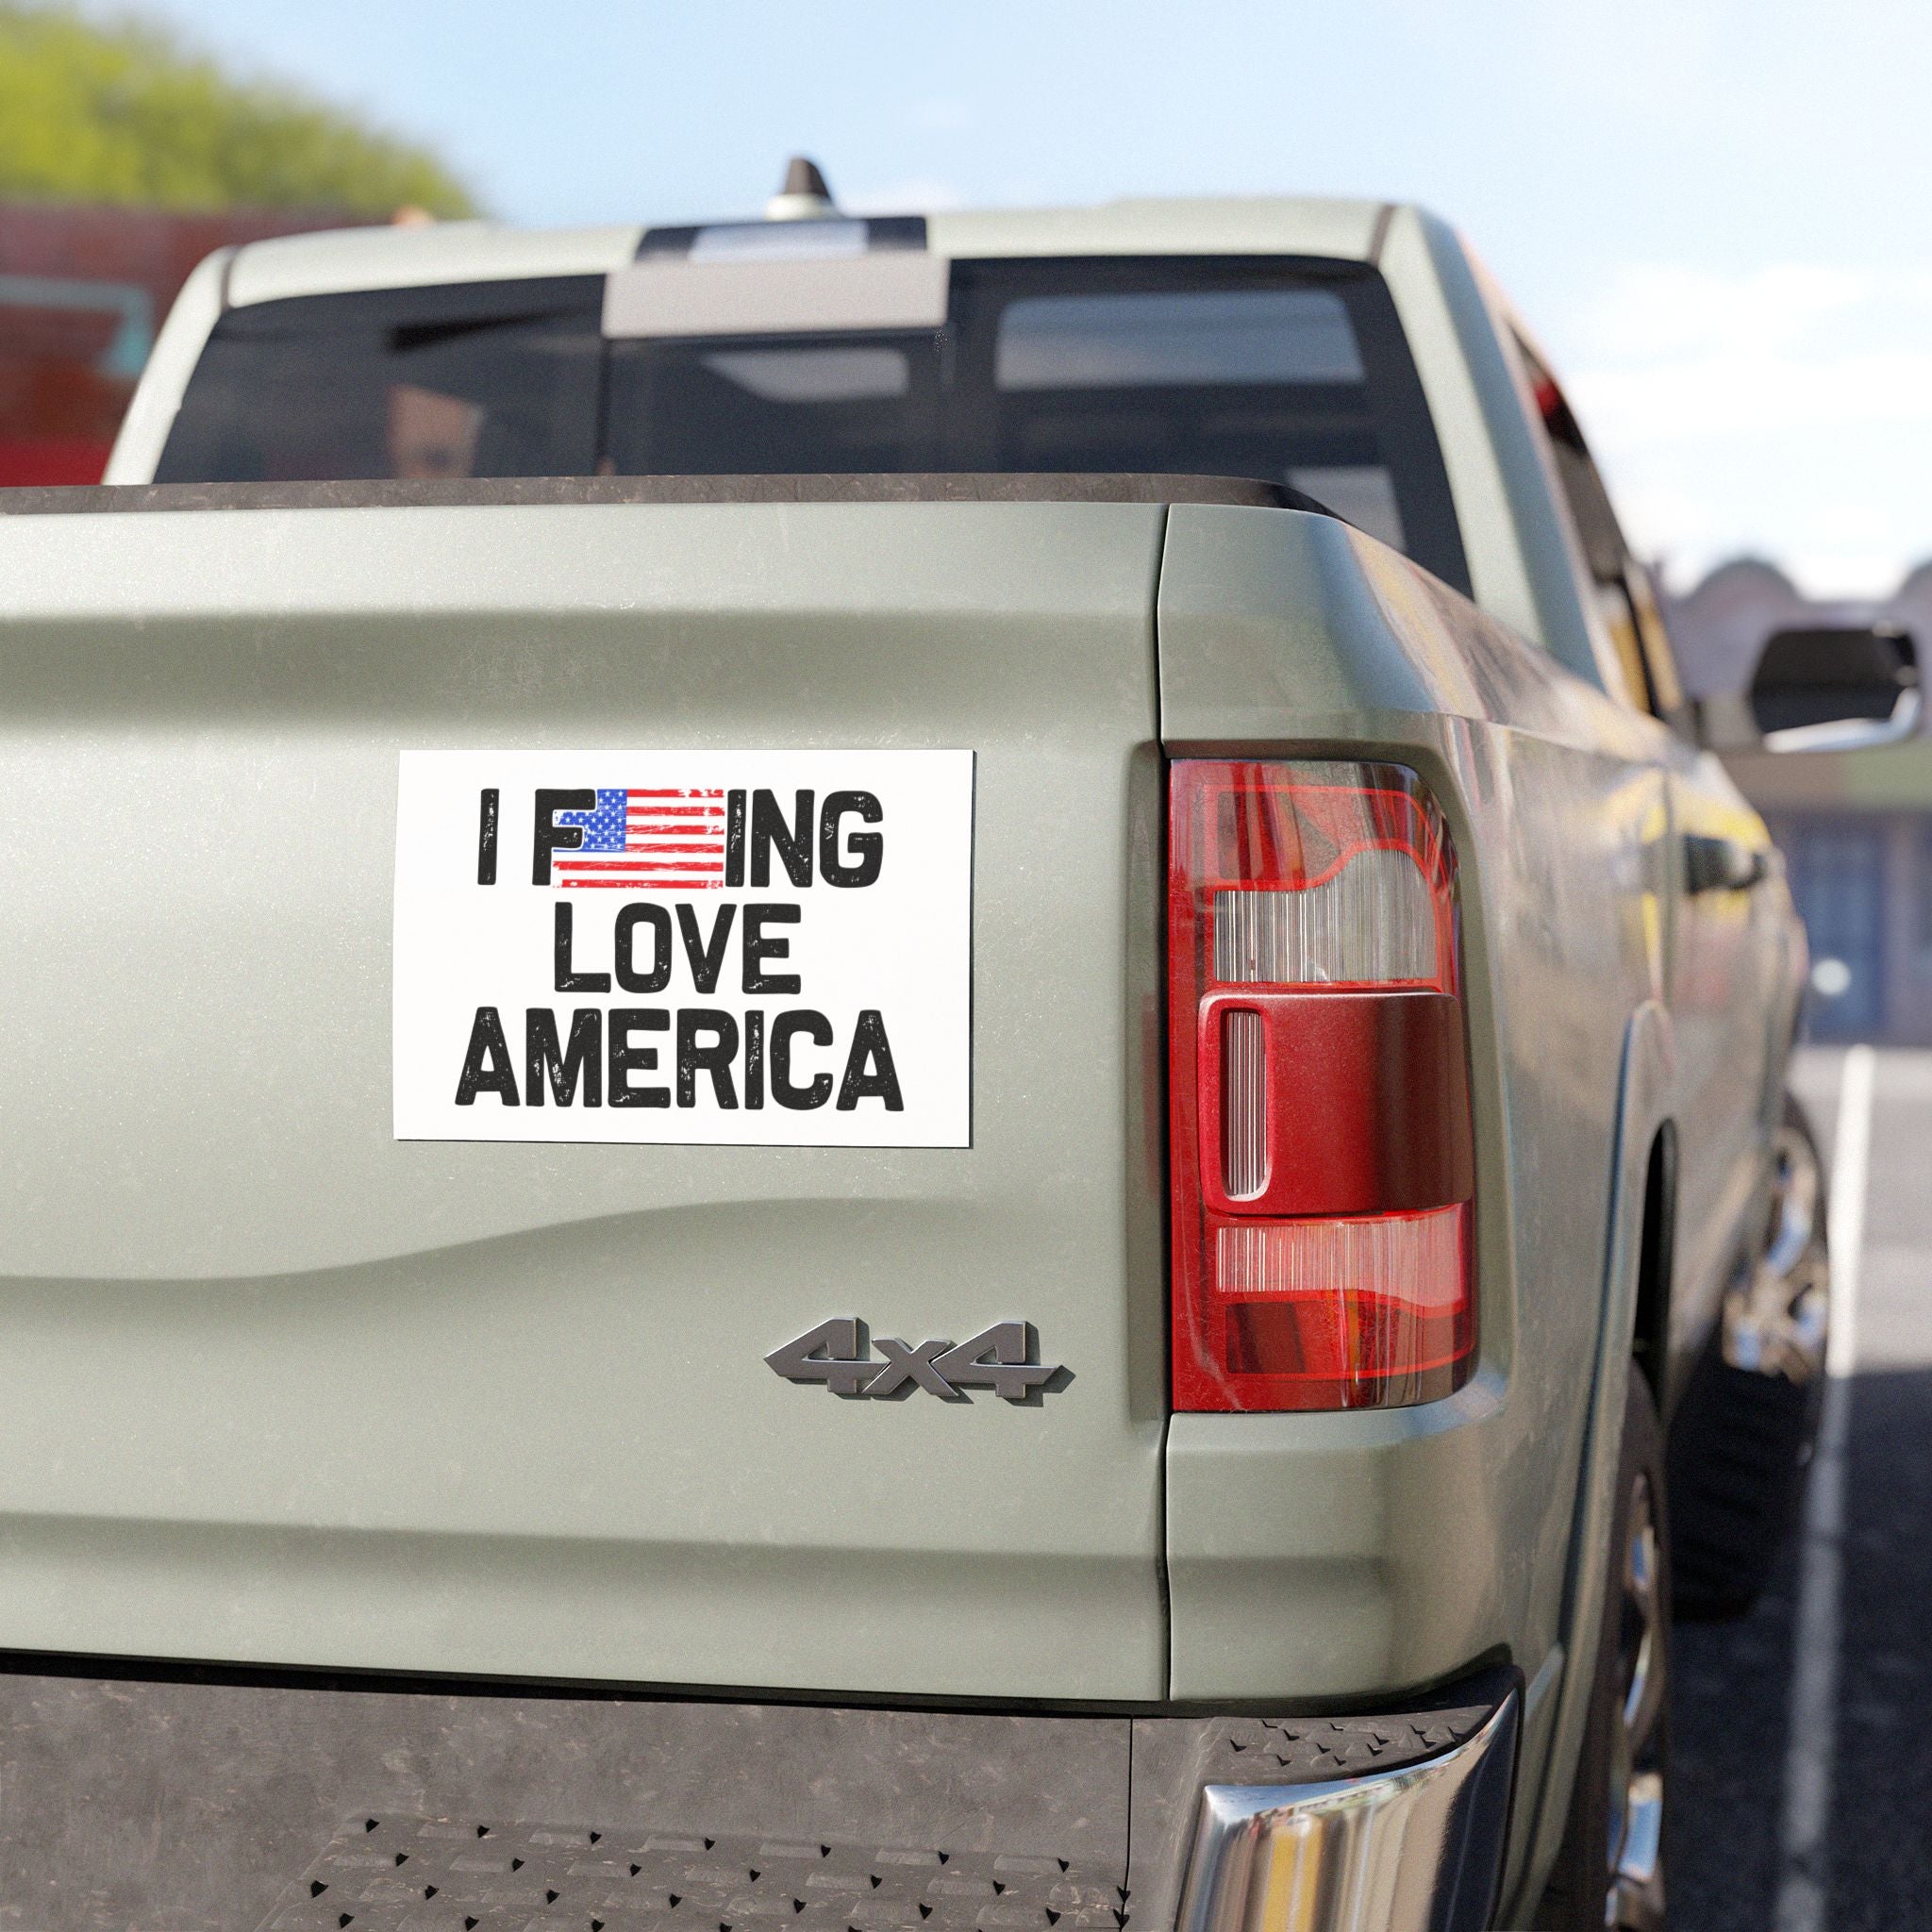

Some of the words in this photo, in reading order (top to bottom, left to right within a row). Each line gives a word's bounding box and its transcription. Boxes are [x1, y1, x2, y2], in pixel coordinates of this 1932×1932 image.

[477, 788, 500, 885] I
[554, 901, 802, 995] LOVE
[455, 1007, 905, 1111] AMERICA
